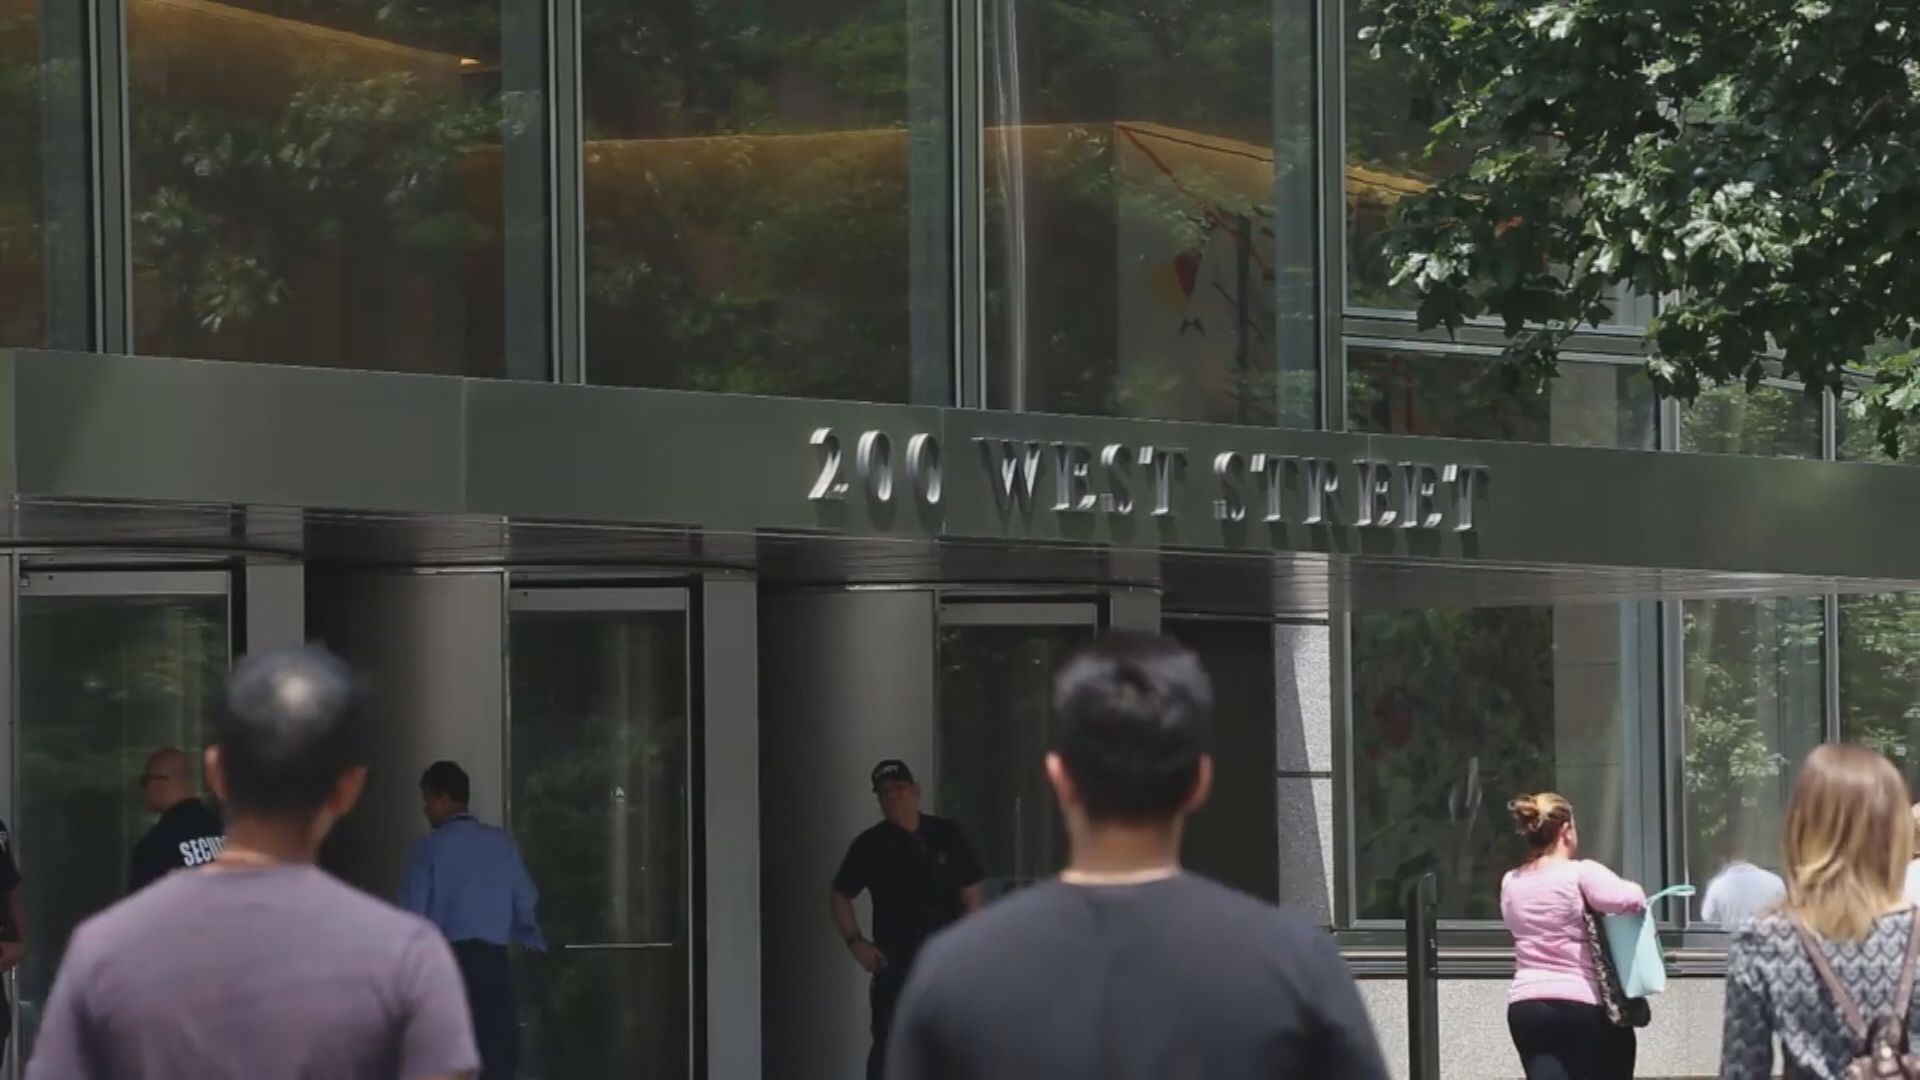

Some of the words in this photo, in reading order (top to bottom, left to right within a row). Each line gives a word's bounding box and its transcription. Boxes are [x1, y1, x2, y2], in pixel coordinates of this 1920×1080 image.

[808, 426, 944, 504] 200
[970, 436, 1188, 517] WEST
[1213, 449, 1490, 531] STREET
